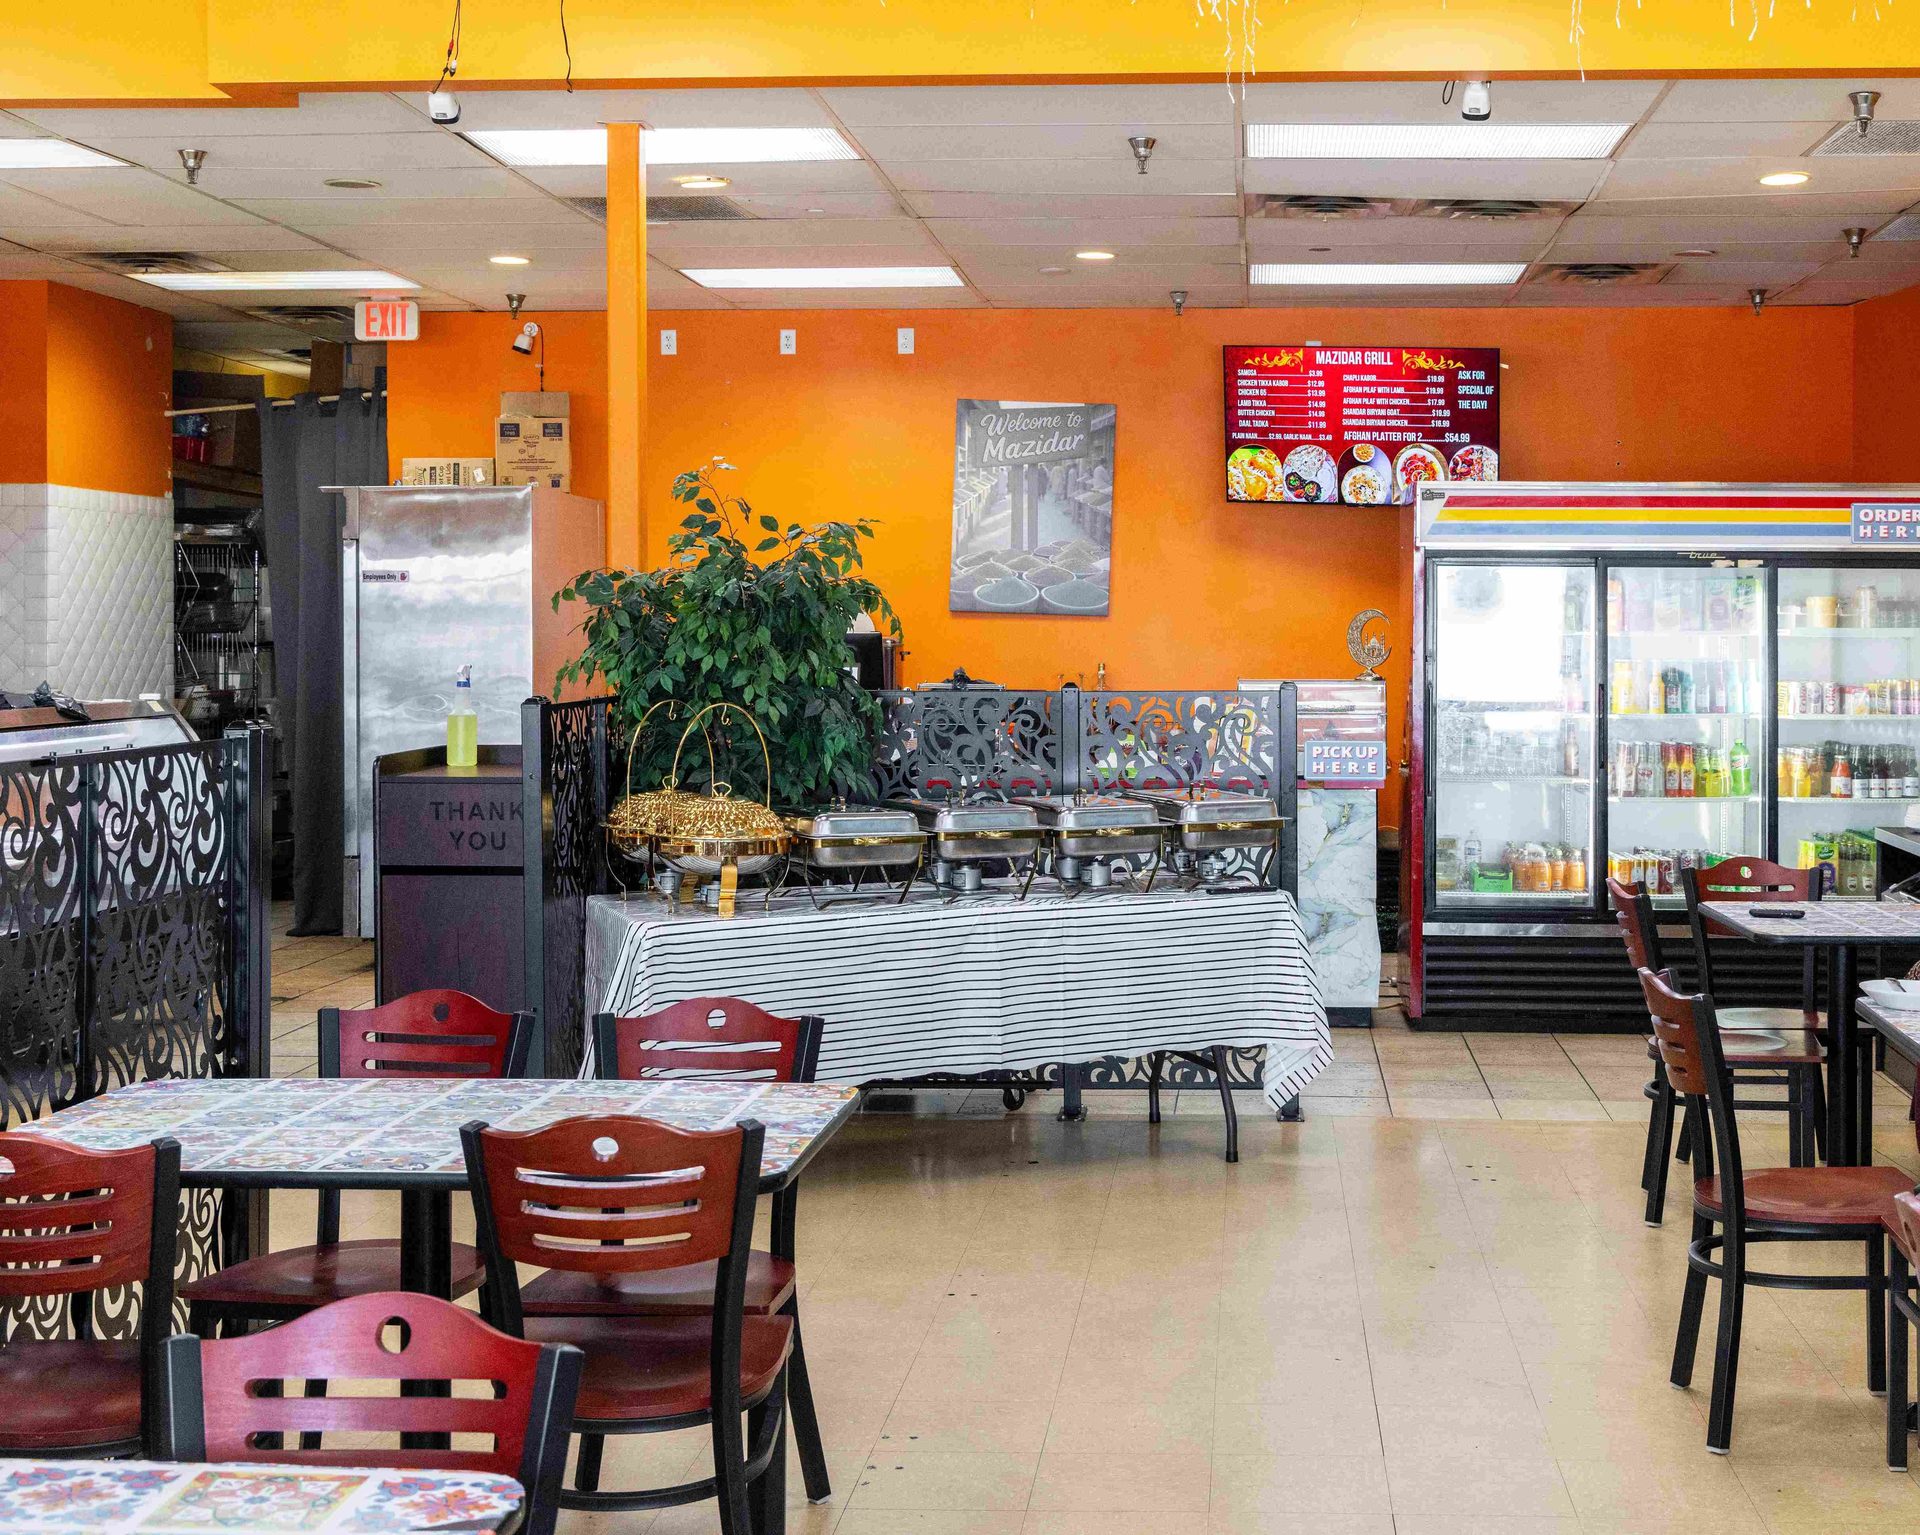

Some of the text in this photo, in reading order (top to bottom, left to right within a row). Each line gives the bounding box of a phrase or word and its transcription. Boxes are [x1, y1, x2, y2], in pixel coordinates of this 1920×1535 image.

[365, 302, 410, 337] EXIT
[1315, 351, 1394, 366] MAZIDAR GRILL
[1457, 370, 1485, 380] ASK FOR
[1457, 385, 1494, 395] SPECIAL OF
[1237, 399, 1251, 407] LAMB
[1252, 399, 1267, 407] TIKKA
[1427, 398, 1445, 406] $17.99
[1457, 400, 1488, 409] THE DAY!
[980, 411, 1085, 437] Welcome to
[1343, 430, 1372, 440] AFGHAN
[1372, 431, 1402, 441] PLATTER
[1402, 432, 1417, 441] FOR
[1444, 432, 1470, 443] $54.99
[982, 431, 1085, 463] Mazidar
[1859, 508, 1920, 523] ORDER
[362, 573, 397, 581] Employees Only
[1312, 745, 1379, 759] PICK UP
[429, 801, 524, 821] THANK
[449, 831, 507, 851] YOU
